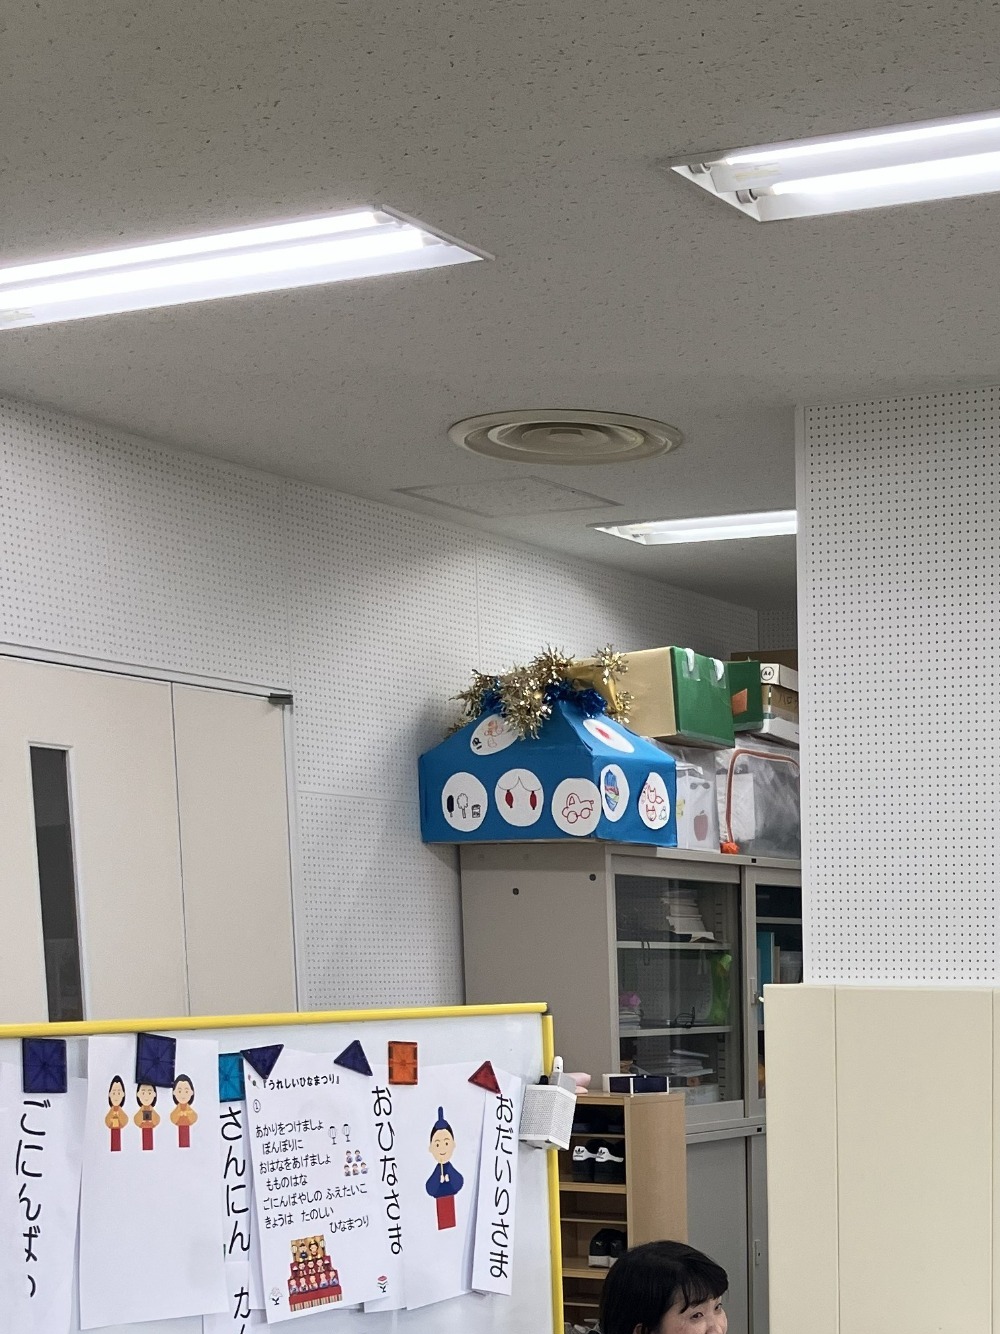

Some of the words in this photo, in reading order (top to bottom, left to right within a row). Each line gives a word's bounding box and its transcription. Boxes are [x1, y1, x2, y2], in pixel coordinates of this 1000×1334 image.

[263, 1073, 340, 1090] 『うれしいひなまつり』
[255, 1119, 324, 1138] あかりをつけましょ
[262, 1139, 304, 1155] ぼんぼりに
[259, 1153, 332, 1174] おはなをあげましょ
[371, 1085, 403, 1255] おひなさま
[266, 1174, 308, 1191] もものはな
[489, 1093, 514, 1279] おだいりさま
[263, 1190, 322, 1211] ごにんばやしの
[325, 1183, 368, 1200] ふえたいこ
[264, 1213, 294, 1229] きょうは
[301, 1207, 334, 1222] たのしい
[329, 1215, 369, 1233] ひなまつり
